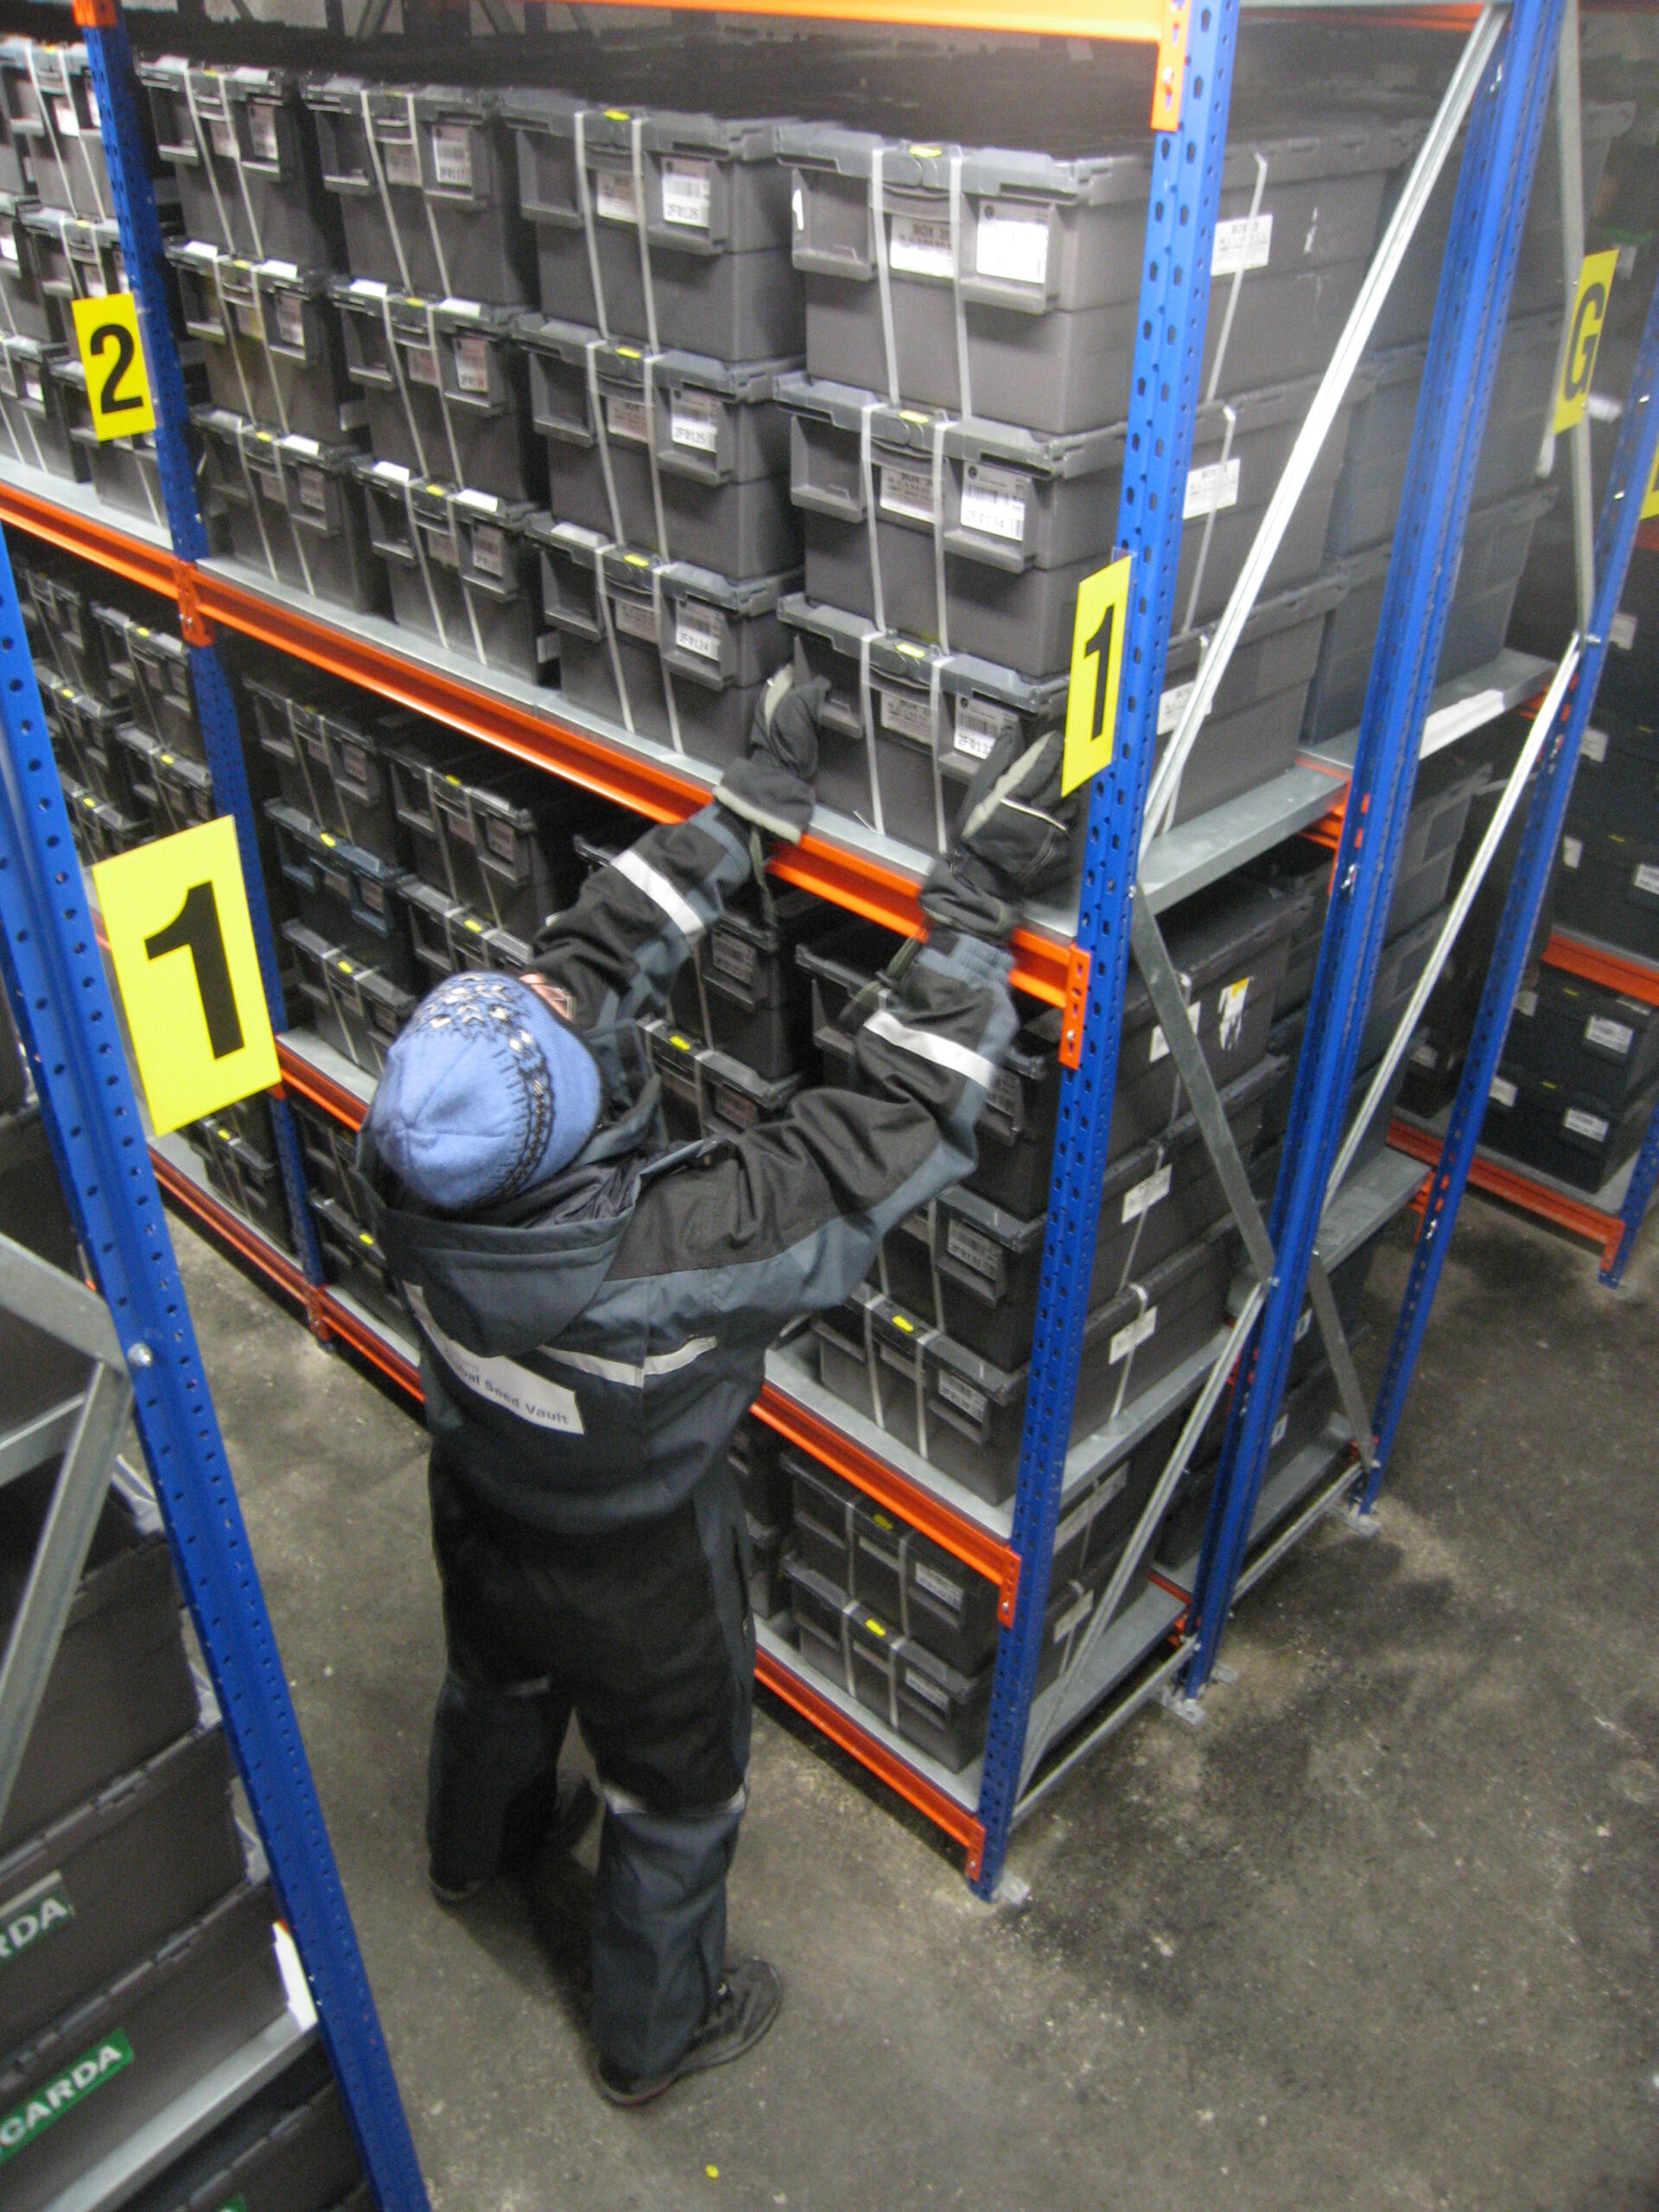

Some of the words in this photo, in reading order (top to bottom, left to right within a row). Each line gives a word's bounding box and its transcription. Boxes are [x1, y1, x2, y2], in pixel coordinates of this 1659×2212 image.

[90, 323, 144, 415] 2
[1564, 283, 1605, 402] G
[1084, 603, 1116, 743] 1
[143, 879, 246, 1060] 1
[485, 1380, 520, 1408] Seed
[524, 1402, 569, 1424] Vault
